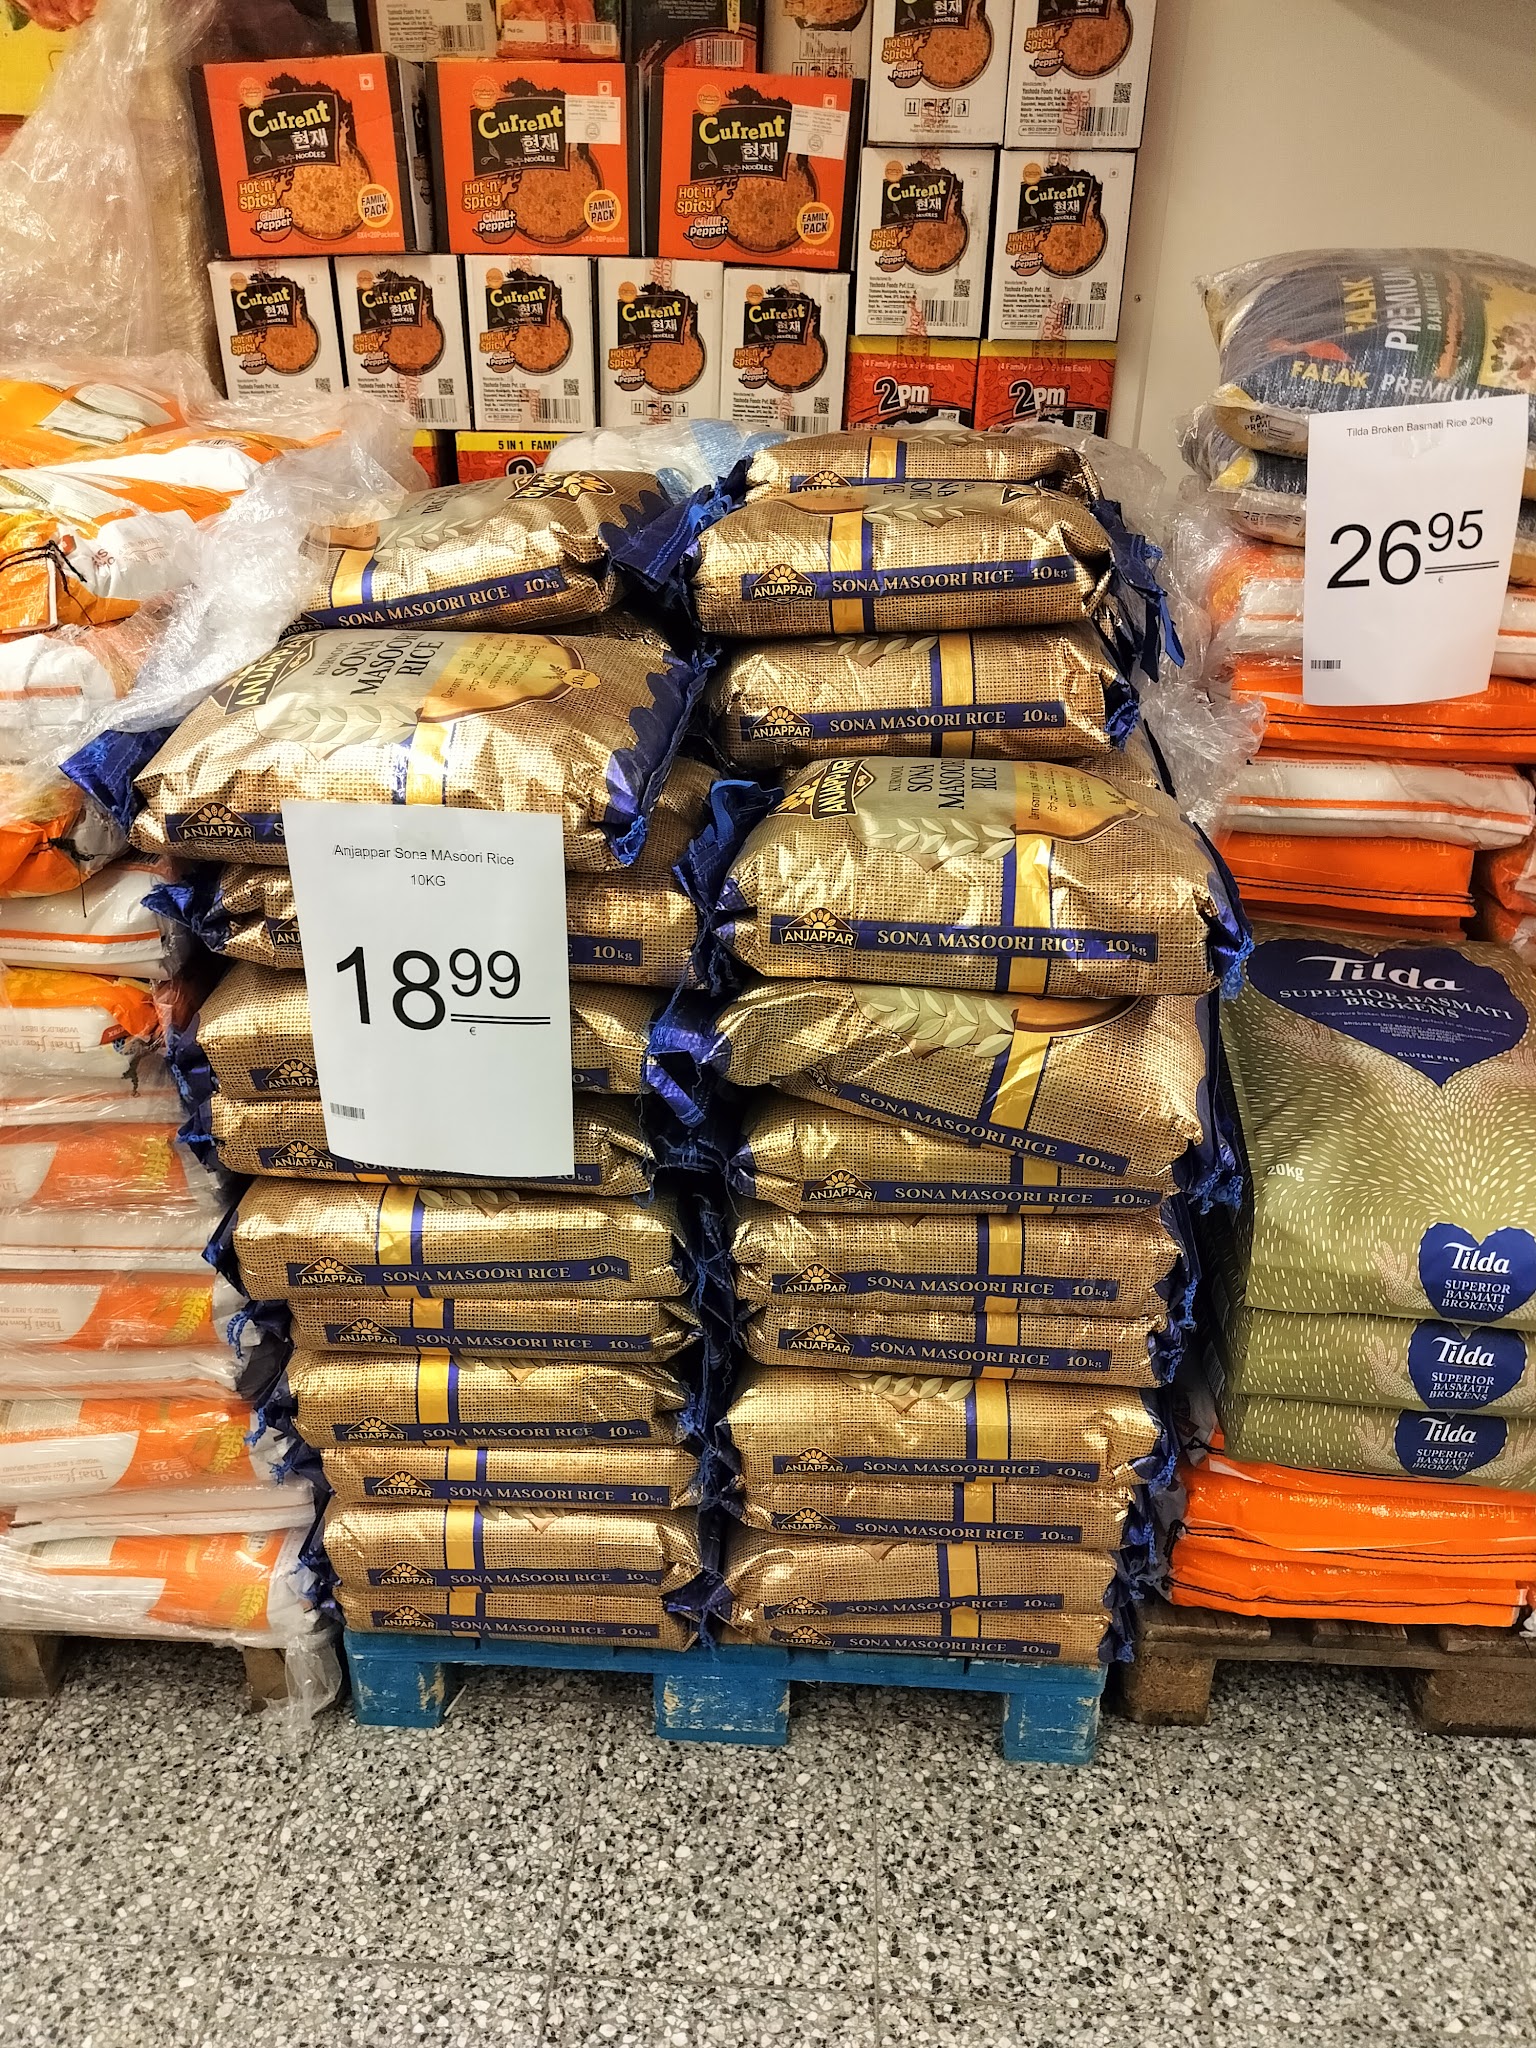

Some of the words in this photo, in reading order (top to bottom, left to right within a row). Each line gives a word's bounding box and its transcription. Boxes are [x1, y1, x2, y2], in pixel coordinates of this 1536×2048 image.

[248, 100, 331, 138] Current
[478, 105, 564, 139] Current
[699, 115, 785, 144] Current
[291, 129, 329, 150] 현재
[521, 132, 559, 153] 현재
[740, 141, 779, 162] 현재
[361, 192, 387, 206] FAMILY
[887, 178, 947, 203] Current
[1024, 181, 1085, 204] Current
[364, 205, 388, 218] PACK
[588, 199, 615, 211] FAMILY
[591, 209, 615, 223] PACK
[802, 212, 829, 223] FAMILY
[803, 221, 827, 234] PACK
[236, 287, 290, 309] Current
[362, 286, 417, 309] Current
[490, 286, 546, 307] Current
[622, 301, 681, 322] Current
[748, 303, 805, 323] Current
[1384, 267, 1420, 351] PREMIUM
[1290, 360, 1371, 389] FALAK
[1346, 427, 1368, 437] Tilda
[1371, 424, 1404, 435] Broken
[1406, 420, 1444, 432] Basmati
[1446, 417, 1467, 428] Rice
[1469, 415, 1493, 427] 20kg
[499, 441, 503, 450] 5
[507, 441, 515, 450] IN
[520, 441, 523, 450] 1
[1327, 519, 1422, 589] 26
[1427, 509, 1483, 552] 95
[753, 583, 813, 598] ANJAPPAR
[832, 578, 880, 593] SONA
[883, 572, 968, 592] MASOORI
[971, 569, 1015, 583] RICE
[1438, 576, 1444, 584] €
[338, 610, 385, 628] SONA
[387, 596, 466, 621] MASOORI
[469, 585, 511, 610] RICE
[331, 639, 386, 677] SONA
[396, 641, 445, 676] RICE
[751, 724, 811, 739] ANJAPPAR
[830, 717, 877, 733] SONA
[880, 713, 962, 730] MASOORI
[965, 711, 1006, 725] RICE
[819, 759, 857, 813] ANJAPPAR
[907, 763, 935, 793] SONA
[971, 765, 998, 791] RICE
[182, 825, 253, 840] ANJAPPAR
[333, 844, 391, 859] Anjappar
[395, 847, 428, 861] Sona
[432, 850, 483, 864] MAsoori
[487, 853, 514, 866] Rice
[410, 874, 447, 888] 10KG
[783, 929, 854, 946] ANJAPPAR
[877, 929, 932, 947] SONA
[937, 932, 1035, 951] MASOORI
[1041, 937, 1086, 953] RICE
[1297, 955, 1465, 991] Tilda
[336, 946, 446, 1031] 18
[448, 948, 521, 999] 99
[1279, 988, 1398, 1003] SUPERIOR
[1406, 994, 1514, 1020] BASMATI
[1346, 997, 1460, 1019] BROKENS
[469, 1026, 477, 1036] €
[1437, 1055, 1460, 1063] FREE
[859, 1091, 910, 1118] SONA
[914, 1110, 1008, 1144] MASOORI
[1011, 1136, 1058, 1157] RICE
[275, 1157, 334, 1170] ANJAPPAR
[1267, 1163, 1304, 1182] 20kg
[808, 1186, 873, 1200] ANJAPPAR
[895, 1188, 947, 1200] SONA
[951, 1188, 1042, 1202] MASOORI
[1048, 1192, 1093, 1203] RICE
[1443, 1242, 1510, 1274] Tilda
[301, 1274, 364, 1285] ANJAPPAR
[382, 1270, 433, 1282] SONA
[436, 1268, 524, 1282] MASOORI
[528, 1266, 571, 1279] RICE
[784, 1281, 847, 1294] ANJAPPAR
[867, 1276, 916, 1290] SONA
[920, 1279, 1006, 1294] MASOORI
[1012, 1282, 1054, 1295] RICE
[1445, 1279, 1510, 1294] SUPERIOR
[1446, 1290, 1505, 1303] BASMATI
[1441, 1298, 1504, 1313] BROKENS
[1431, 1336, 1495, 1367] Tilda
[1431, 1372, 1494, 1385] SUPERIOR
[1433, 1383, 1489, 1394] BASMATI
[1429, 1391, 1488, 1401] BROKENS
[1418, 1418, 1477, 1444] Tilda
[1416, 1449, 1474, 1458] SUPERIOR
[1417, 1456, 1468, 1465] BASMATI
[785, 1463, 845, 1473] ANJAPPAR
[863, 1461, 911, 1473] SONA
[914, 1462, 994, 1474] MASOORI
[999, 1463, 1040, 1475] RICE
[1412, 1463, 1467, 1471] BROKENS
[376, 1487, 432, 1497] ANJAPPAR
[450, 1486, 493, 1498] SONA
[497, 1488, 572, 1500] MASOORI
[577, 1490, 614, 1501] RICE
